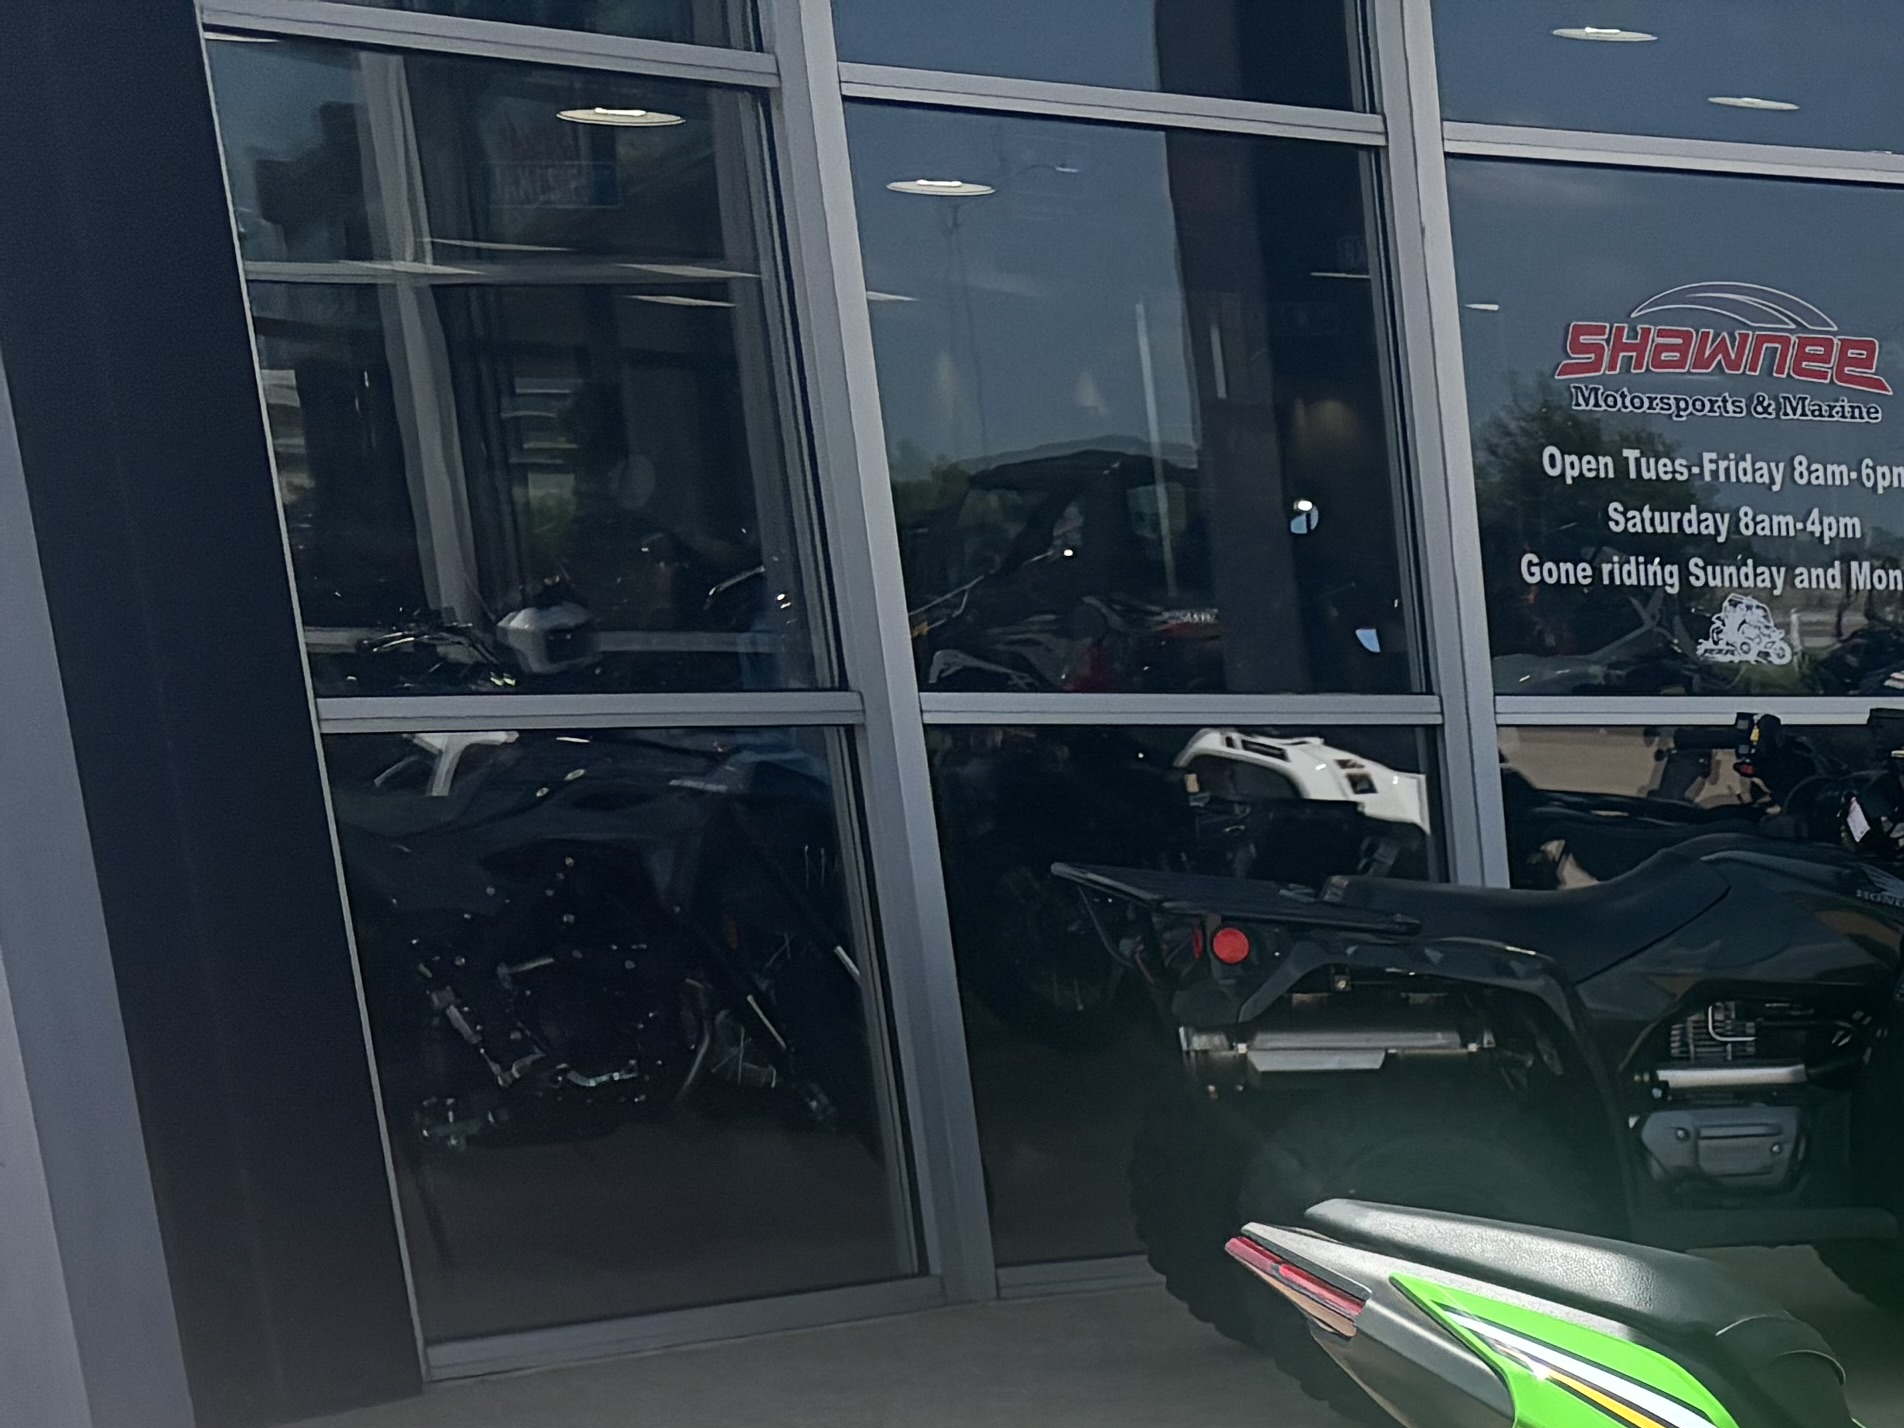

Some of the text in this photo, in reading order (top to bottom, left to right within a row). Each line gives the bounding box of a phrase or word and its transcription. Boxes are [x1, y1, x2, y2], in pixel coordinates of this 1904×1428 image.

[1569, 383, 1882, 423] Motorsports & Marine
[1542, 445, 1615, 485] Open
[1622, 447, 1785, 491] Tues-Friday
[1607, 501, 1862, 545] Saturday 8am-4pm
[1520, 552, 1593, 585] Gone
[1601, 556, 1680, 594] riding
[1688, 556, 1786, 596] Sunday
[1793, 560, 1842, 591] and
